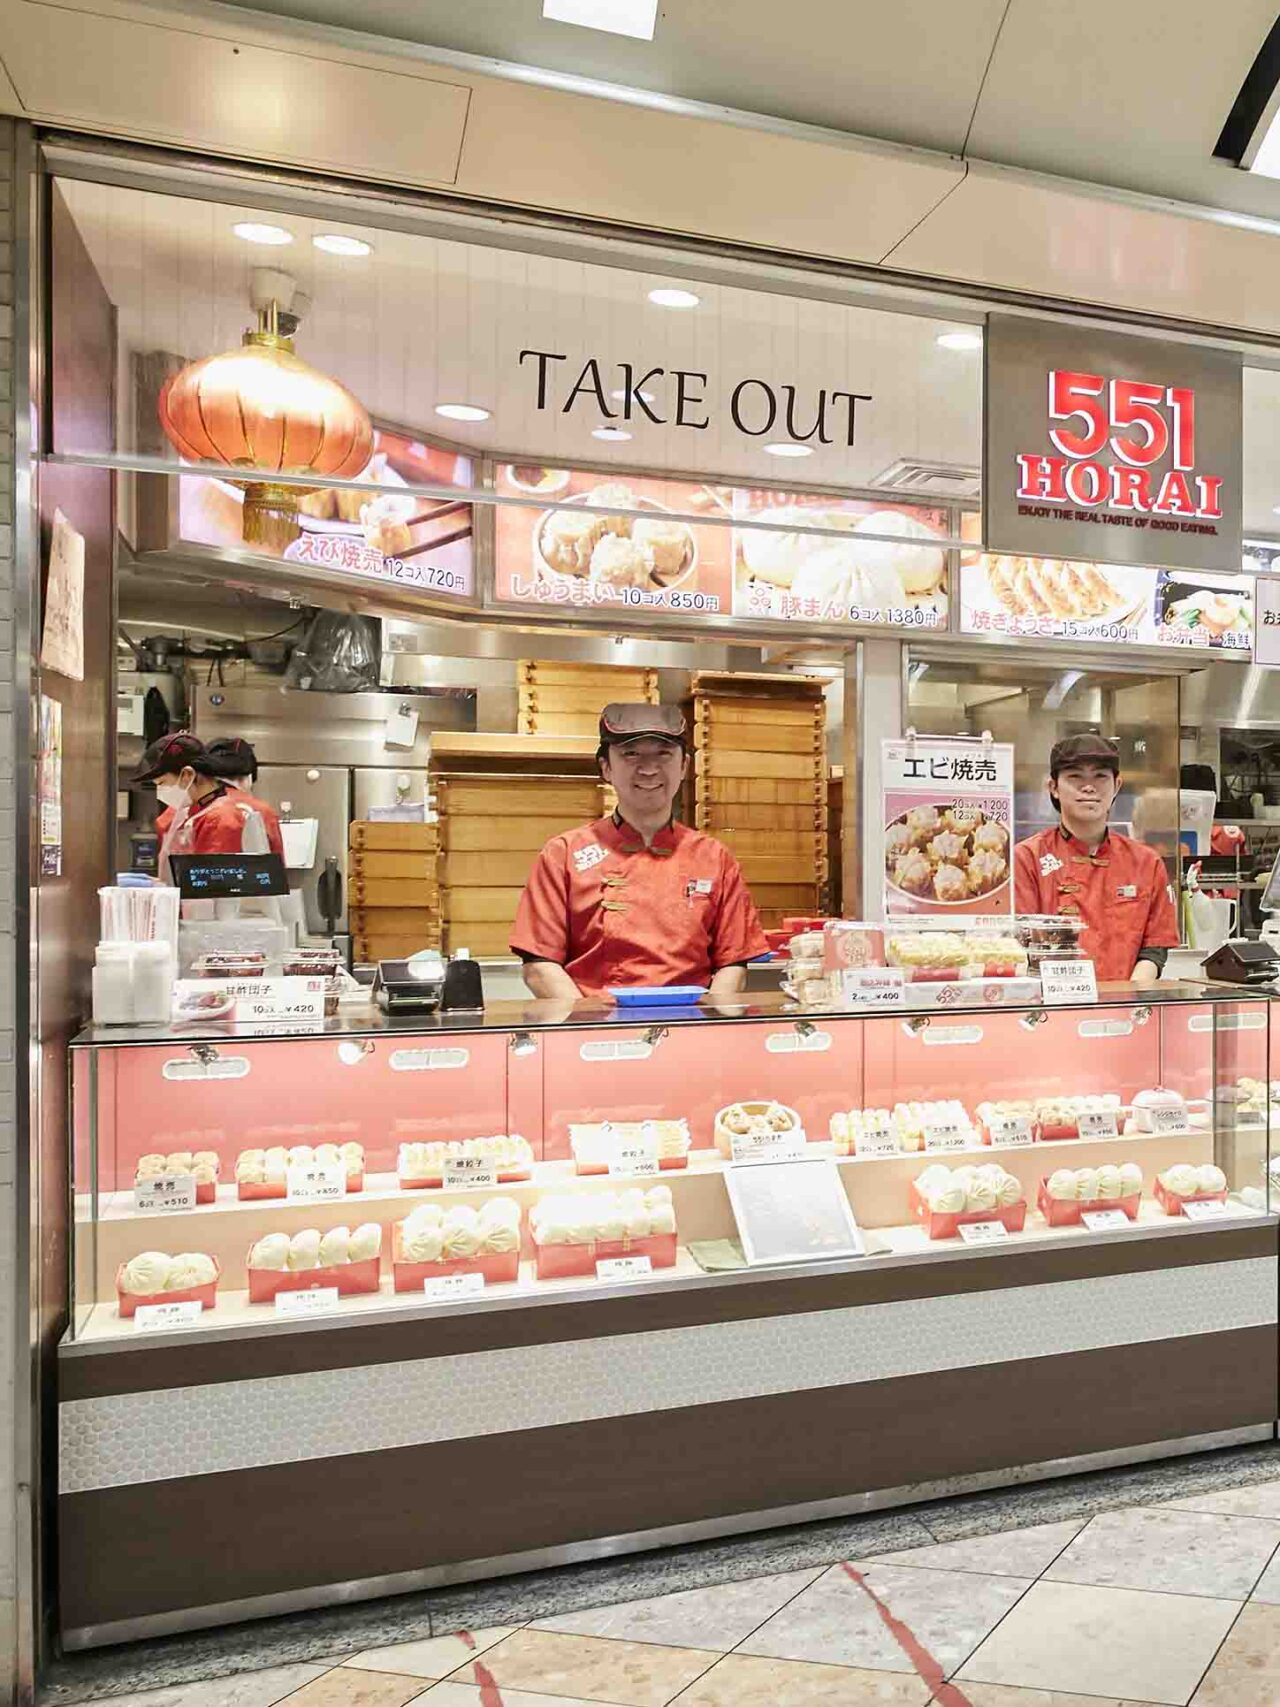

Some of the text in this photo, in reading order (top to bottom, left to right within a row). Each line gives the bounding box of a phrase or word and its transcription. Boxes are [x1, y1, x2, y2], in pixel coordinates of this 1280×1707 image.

[519, 350, 872, 446] TAKE OUT
[1048, 369, 1195, 471] 551
[1016, 453, 1223, 519] HORAI
[1053, 508, 1073, 520] THE
[1102, 513, 1133, 527] TASTE
[1135, 517, 1149, 528] OF
[299, 533, 382, 573] えび焼売
[512, 575, 615, 602] しゅうまい
[780, 595, 844, 619] 豚まん
[903, 757, 997, 781] エビ焼売
